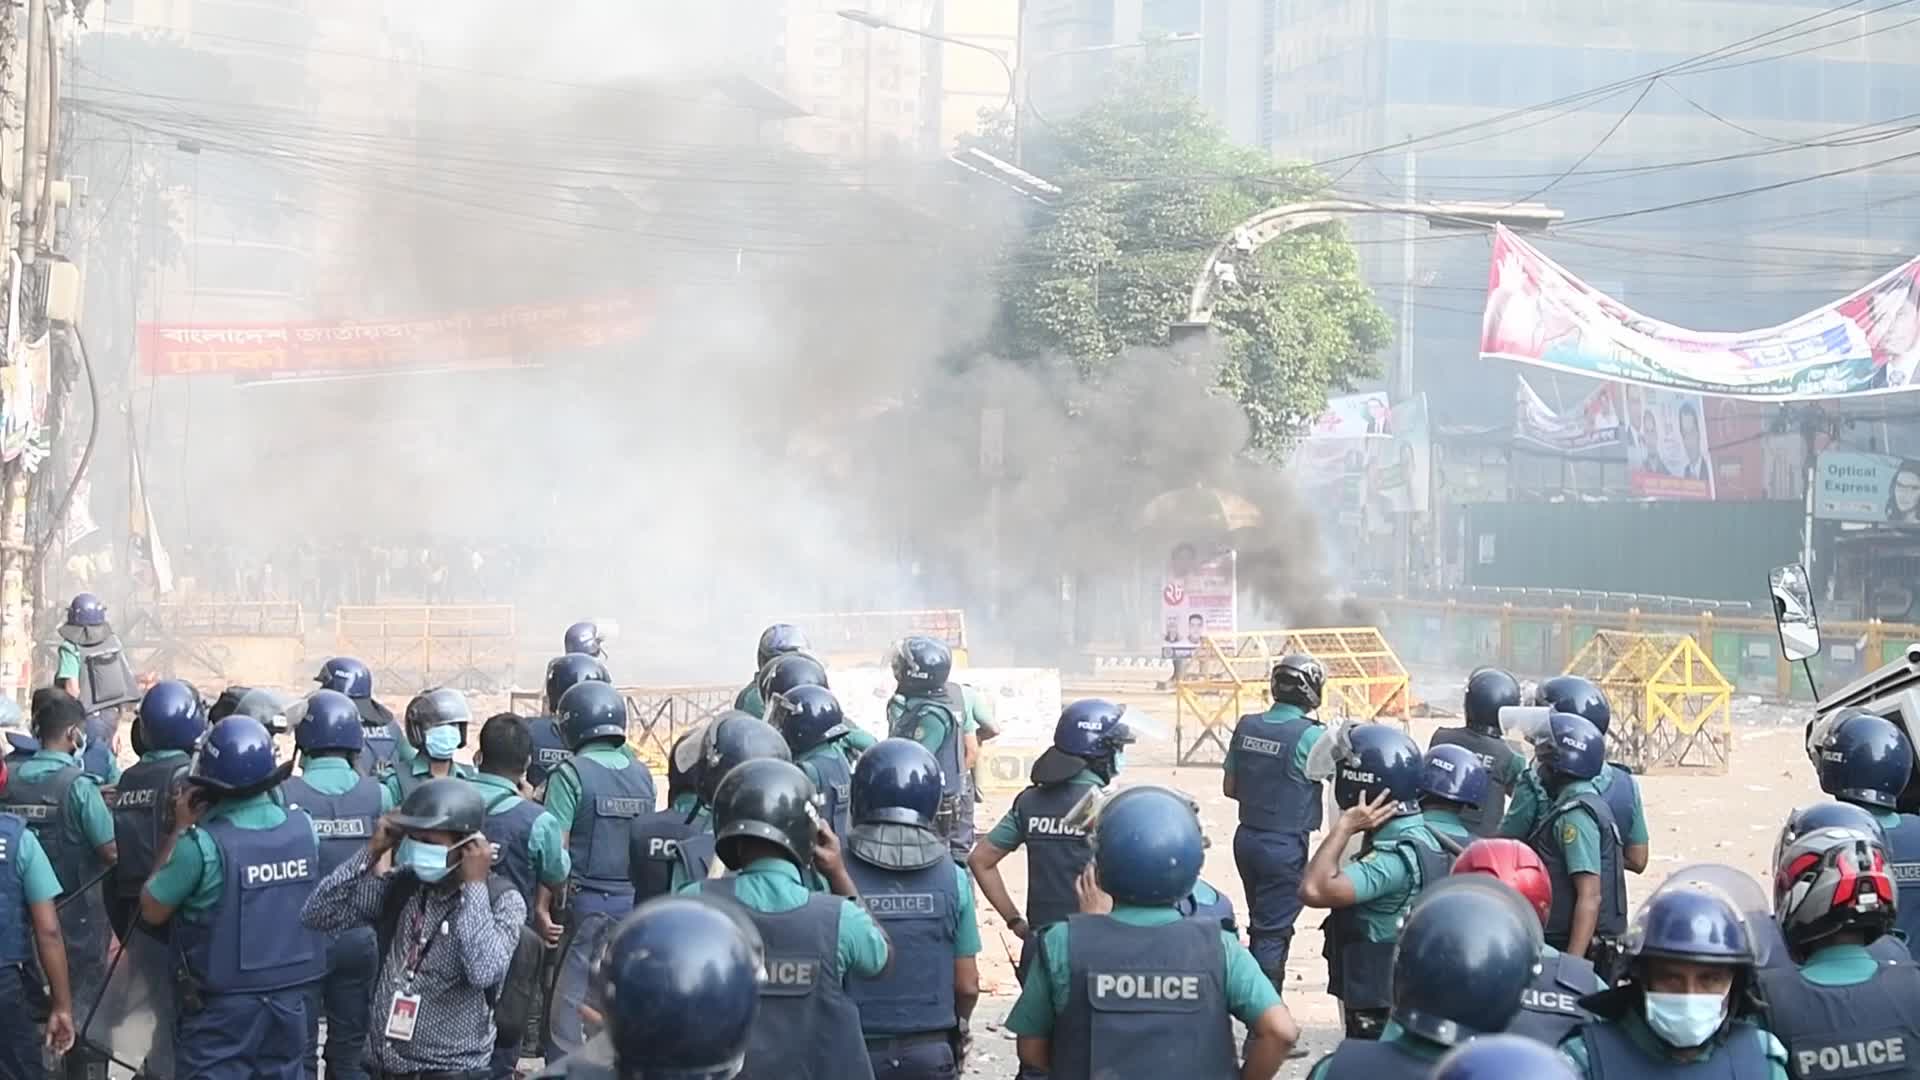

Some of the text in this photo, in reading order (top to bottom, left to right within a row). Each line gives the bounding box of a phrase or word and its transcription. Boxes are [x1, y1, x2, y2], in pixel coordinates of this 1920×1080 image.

[1828, 464, 1876, 477] Optical
[1825, 480, 1879, 494] Express
[361, 726, 392, 738] OLICE
[1077, 721, 1103, 731] POLICE
[1562, 736, 1588, 752] POLICE
[1431, 758, 1455, 771] POLICE
[1342, 769, 1375, 783] POLICE
[315, 822, 358, 834] POLICE
[248, 858, 308, 884] POLICE
[1893, 866, 1920, 878] OLICE
[870, 898, 926, 911] POLICE
[769, 961, 812, 984] ICE
[1097, 974, 1200, 1000] POLICE
[1520, 989, 1575, 1011] LICE
[1798, 1037, 1905, 1074] POLICE
